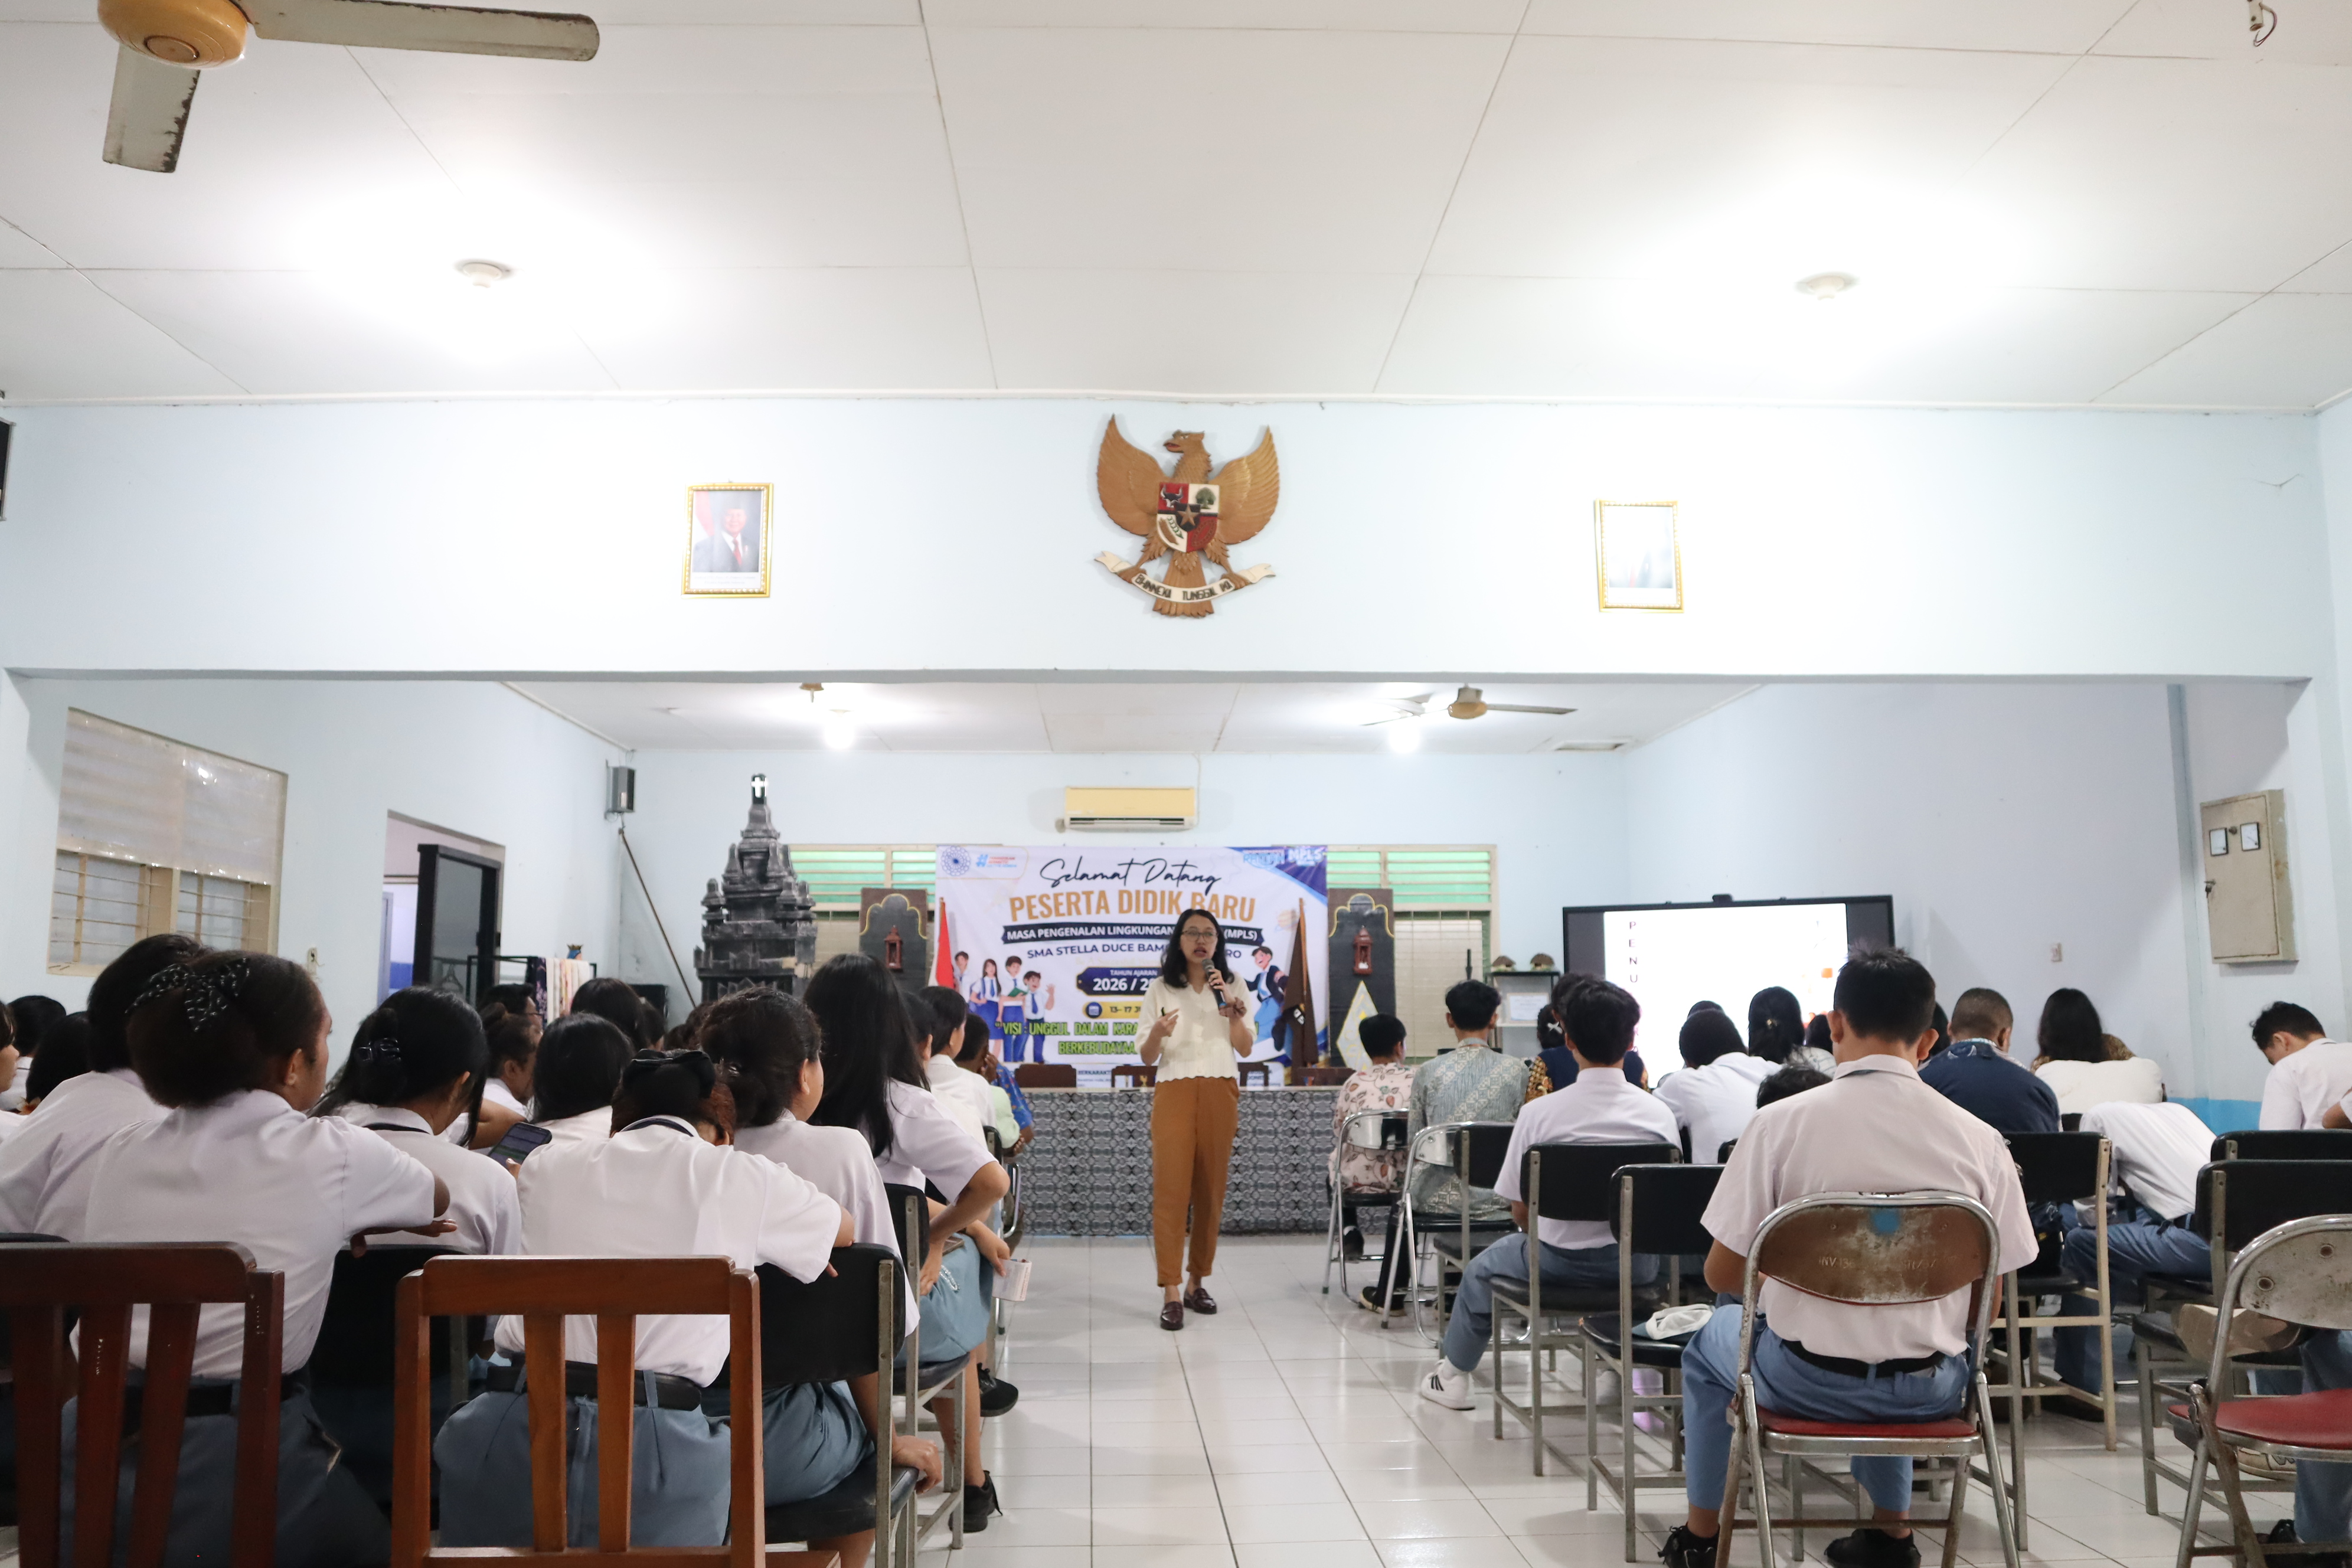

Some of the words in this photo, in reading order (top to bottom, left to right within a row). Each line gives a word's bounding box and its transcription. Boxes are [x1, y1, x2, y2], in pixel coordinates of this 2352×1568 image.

[1288, 848, 1322, 863] MPLS
[1040, 856, 1143, 888] Selamat
[1144, 858, 1221, 896] Datang
[1010, 890, 1110, 922] PESERTA
[1118, 890, 1183, 915] DIDIK
[1191, 891, 1255, 922] BARU
[1007, 929, 1037, 940] MASA
[1037, 926, 1106, 938] PENGENALAN
[1108, 926, 1175, 936] LINGKUNGAN
[1223, 929, 1257, 941] (MPLS)
[1027, 948, 1053, 959] SMA
[1056, 945, 1098, 956] STELLA
[1102, 943, 1133, 952] DUCE
[1093, 978, 1128, 991] 2026
[1130, 978, 1137, 991] /
[1029, 1022, 1070, 1035] UNGGUL
[1074, 1022, 1108, 1035] DALAM
